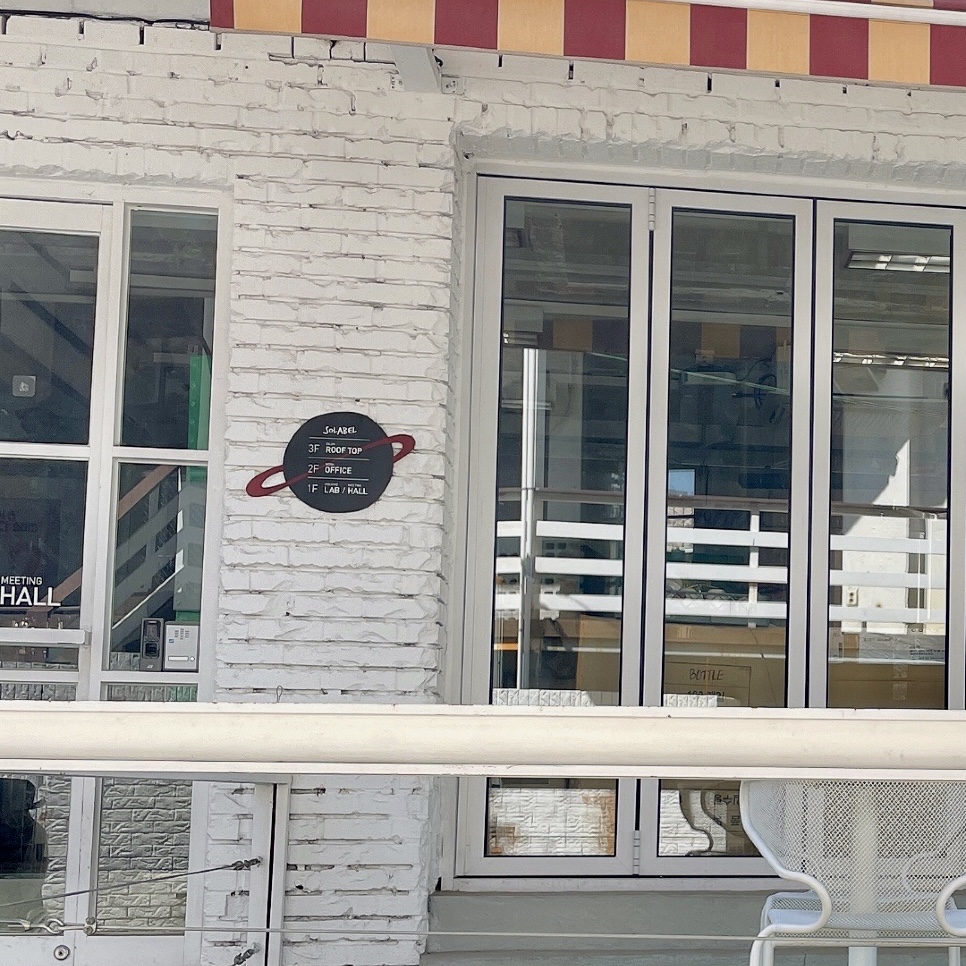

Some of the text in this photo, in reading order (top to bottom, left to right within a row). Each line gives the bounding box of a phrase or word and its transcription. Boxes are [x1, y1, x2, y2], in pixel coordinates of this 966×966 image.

[308, 443, 320, 453] 3F
[325, 446, 346, 454] ROOF
[347, 447, 362, 455] TOP
[307, 464, 352, 475] 2F OFFICE
[308, 483, 319, 493] 1F
[324, 486, 340, 494] LAB
[347, 487, 368, 495] HALL
[1, 575, 43, 585] MEETING
[0, 585, 61, 606] HALL
[689, 668, 724, 681] BOTTLE
